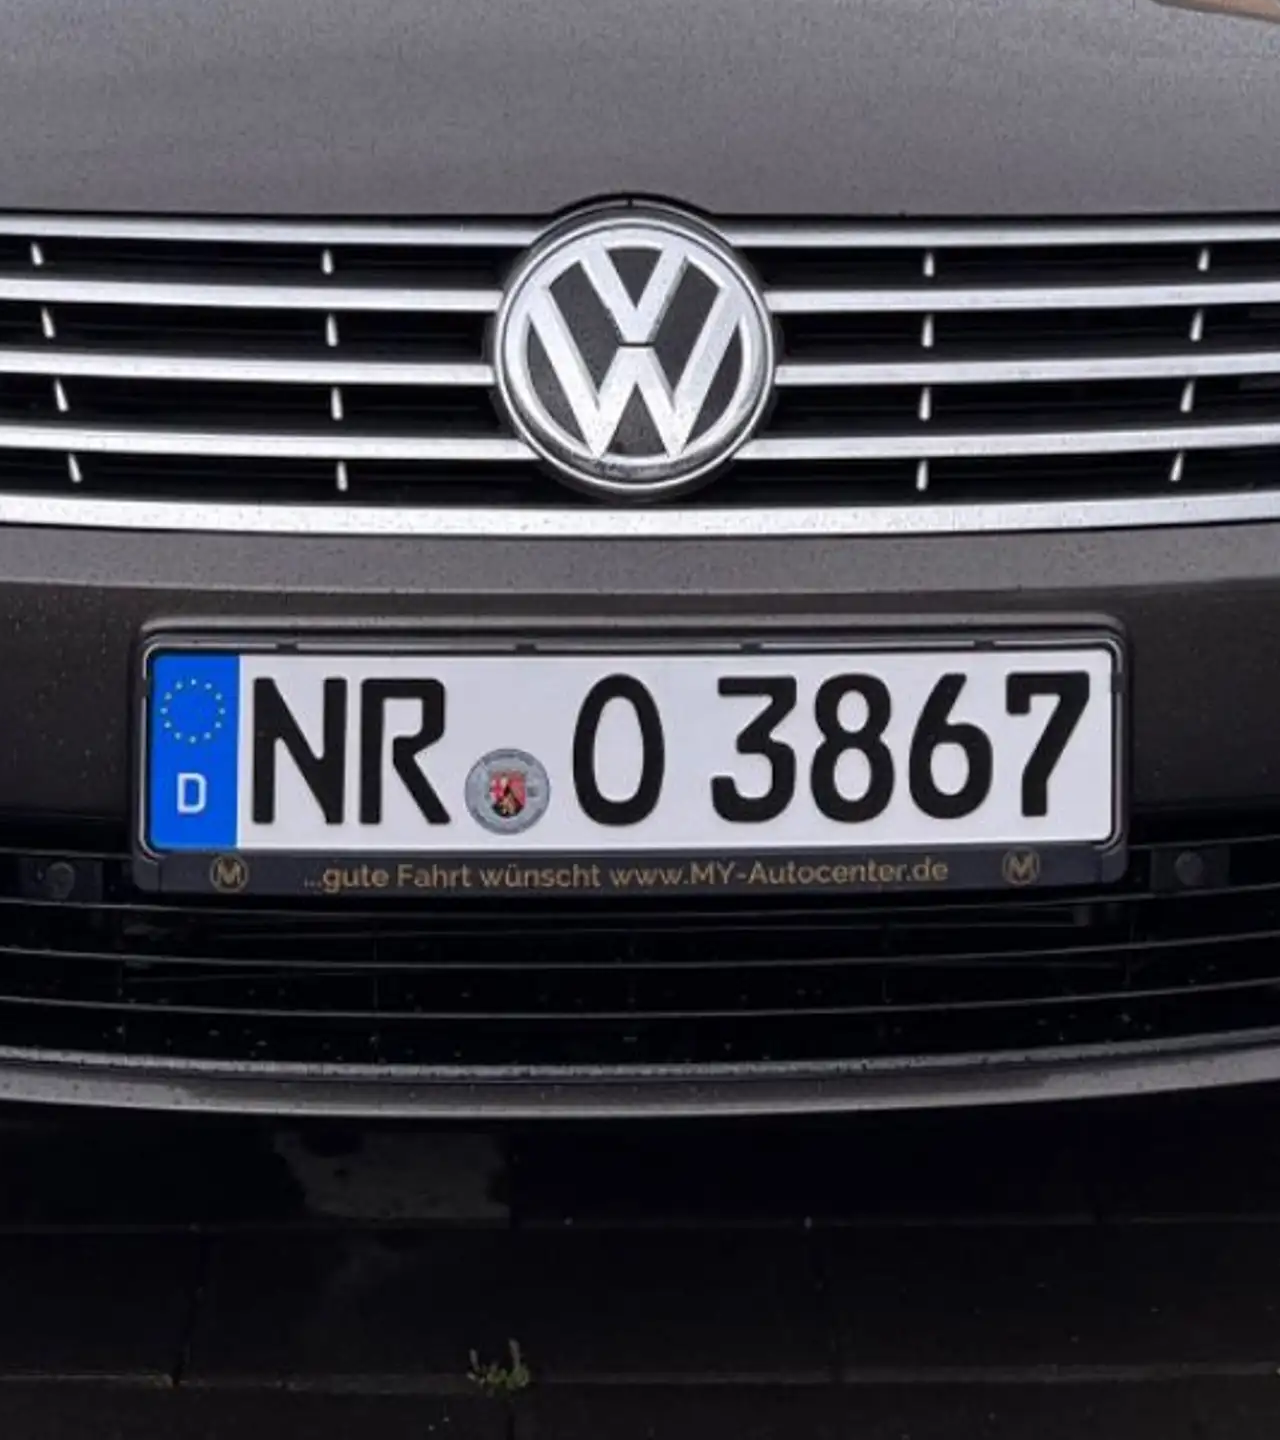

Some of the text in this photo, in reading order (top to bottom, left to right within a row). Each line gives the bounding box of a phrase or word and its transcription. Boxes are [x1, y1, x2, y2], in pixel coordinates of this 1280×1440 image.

[504, 222, 766, 476] VW
[177, 772, 207, 814] D
[251, 676, 451, 826] NR
[572, 672, 663, 826] O
[710, 670, 1092, 824] 3867
[396, 863, 471, 888] Fahrt
[479, 862, 601, 888] wünscht
[608, 858, 949, 888] www.MY-Autocenter.de
